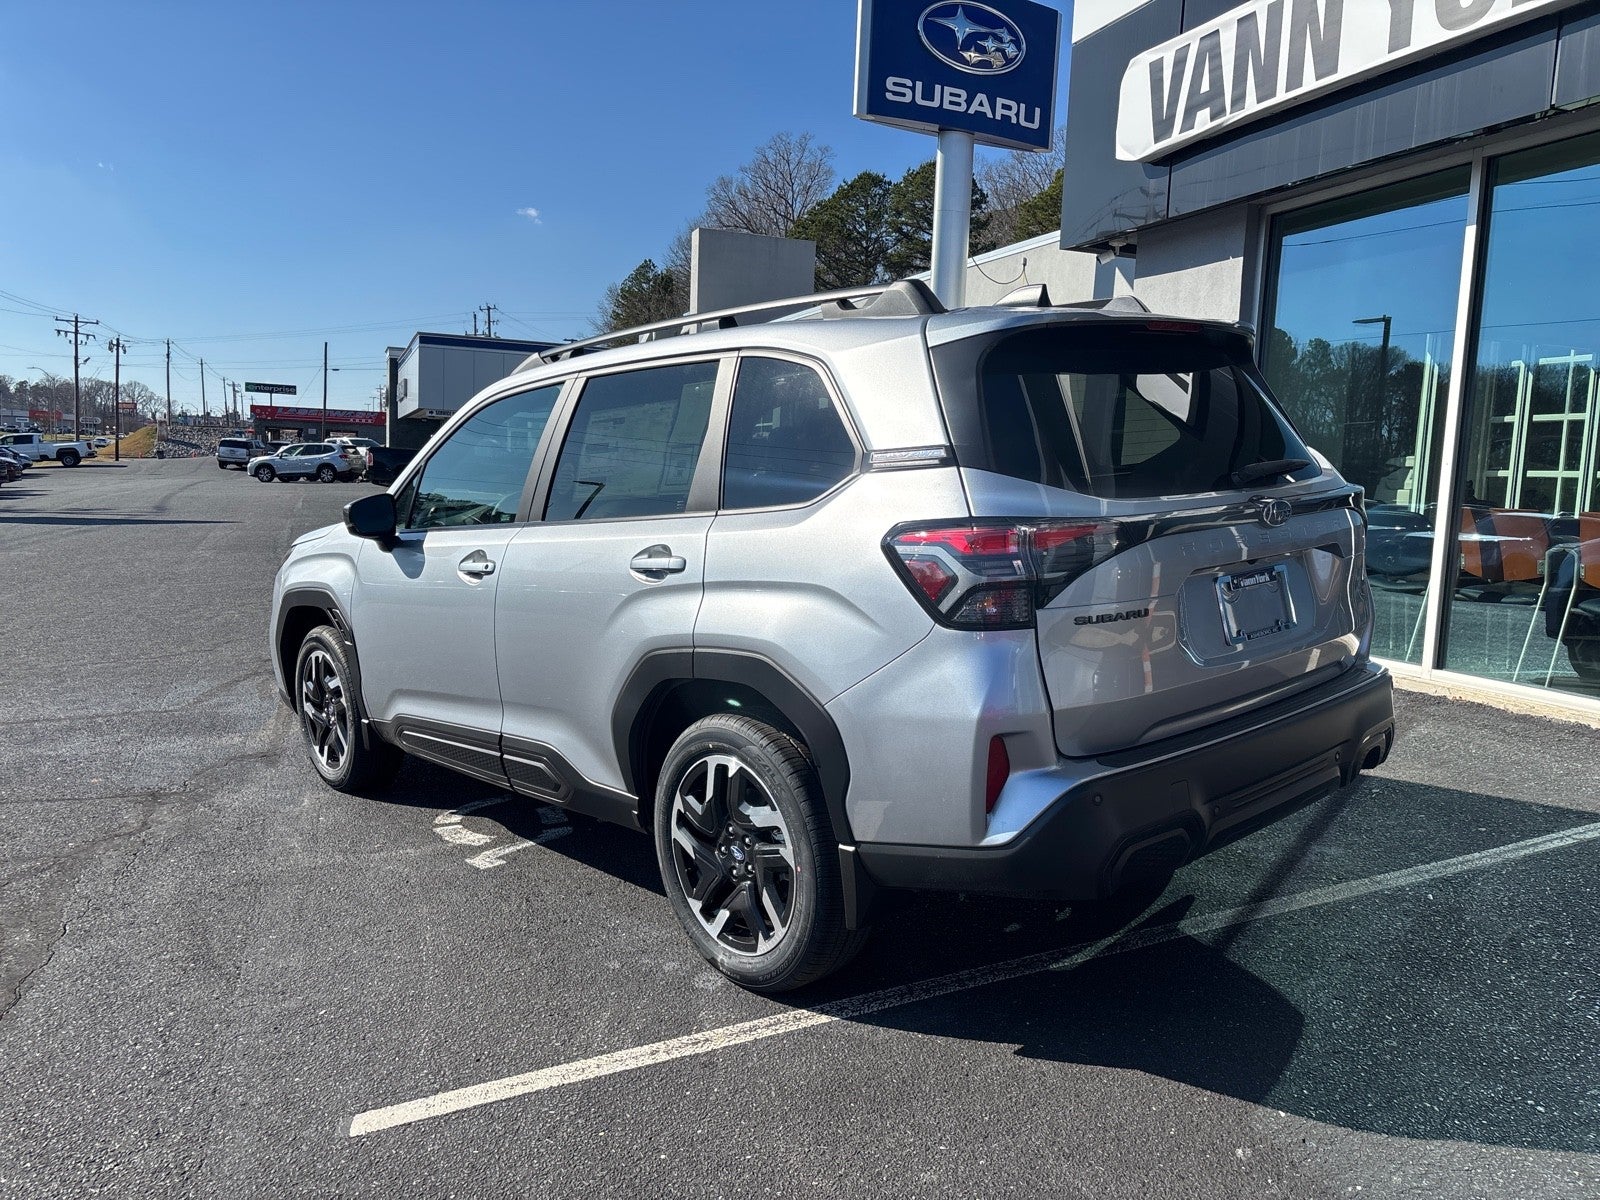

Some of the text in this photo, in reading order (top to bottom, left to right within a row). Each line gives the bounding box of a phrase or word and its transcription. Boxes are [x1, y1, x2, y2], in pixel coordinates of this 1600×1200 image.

[1148, 0, 1345, 142] VANN
[885, 76, 1041, 131] SUBARU
[247, 384, 296, 393] enterprise
[1073, 607, 1150, 626] SUBARU
